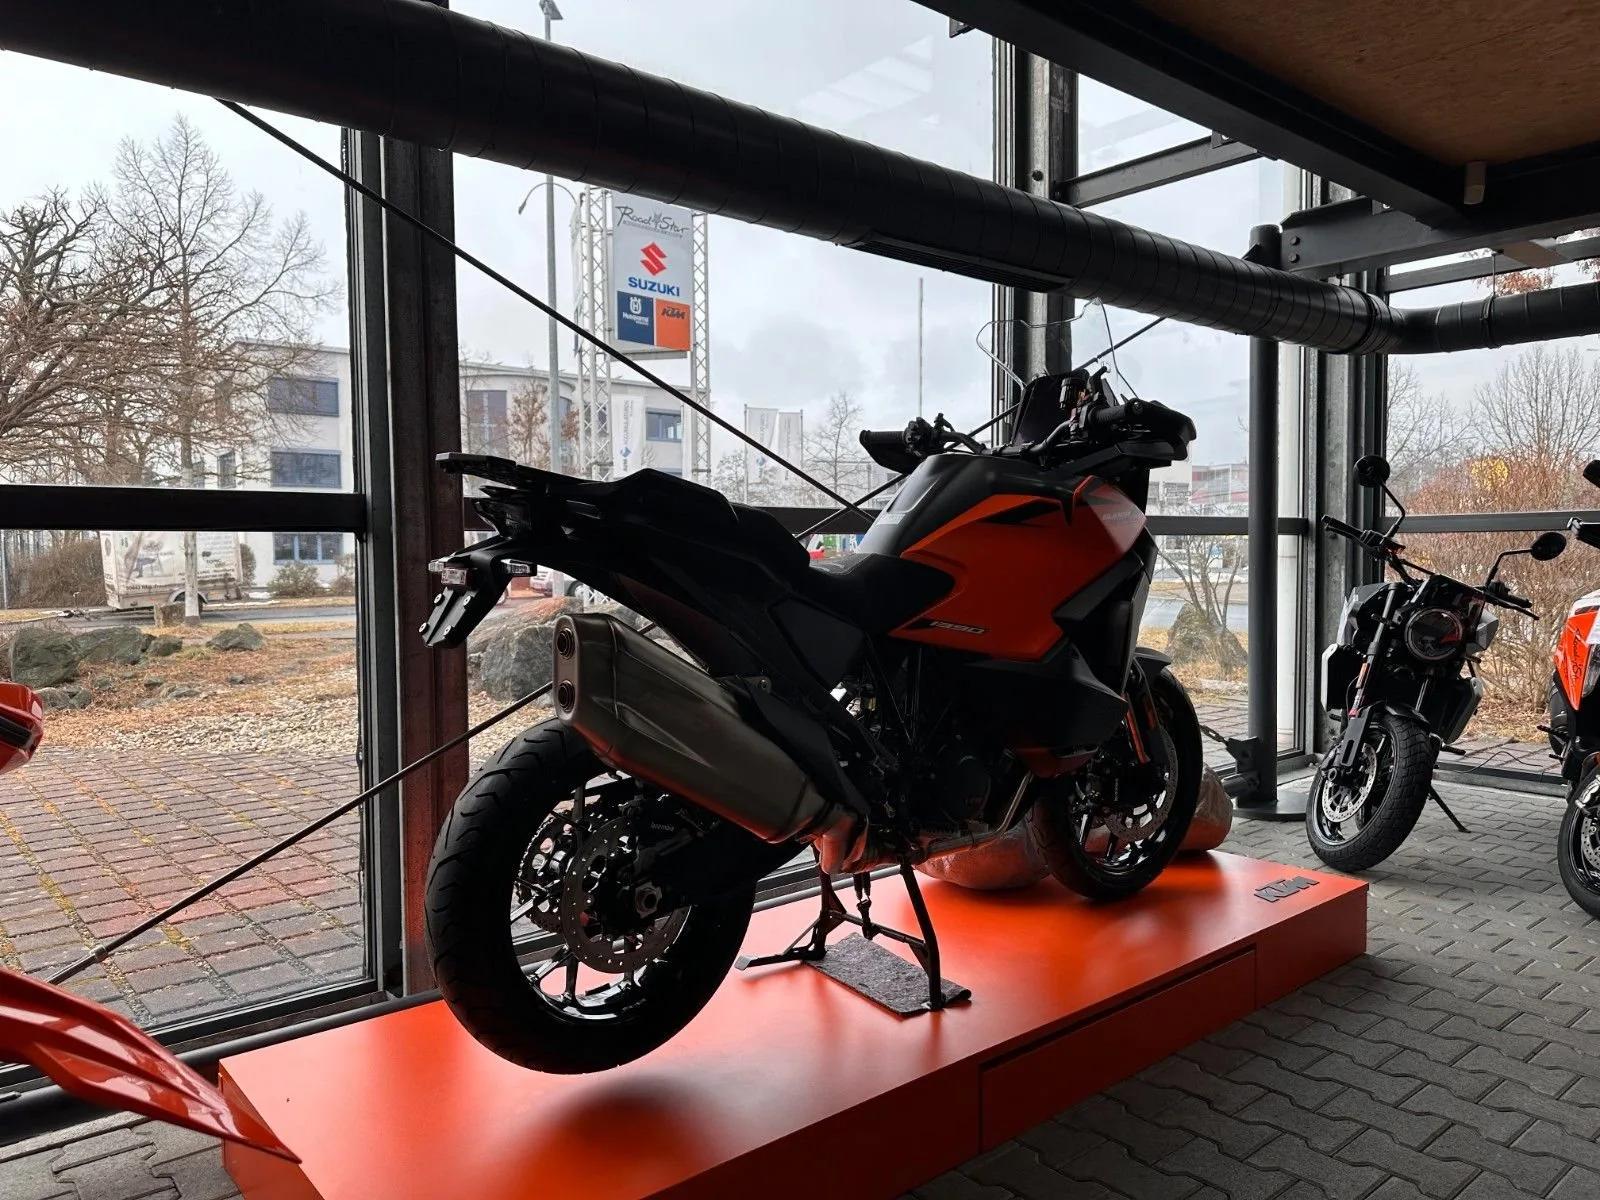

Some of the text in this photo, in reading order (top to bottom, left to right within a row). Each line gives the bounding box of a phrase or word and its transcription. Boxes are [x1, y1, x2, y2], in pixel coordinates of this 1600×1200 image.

[615, 206, 652, 227] Road
[660, 216, 689, 233] Star
[628, 276, 680, 297] SUZUKI
[661, 307, 686, 320] KTM
[929, 621, 985, 634] 1290
[1253, 876, 1320, 903] KTM
